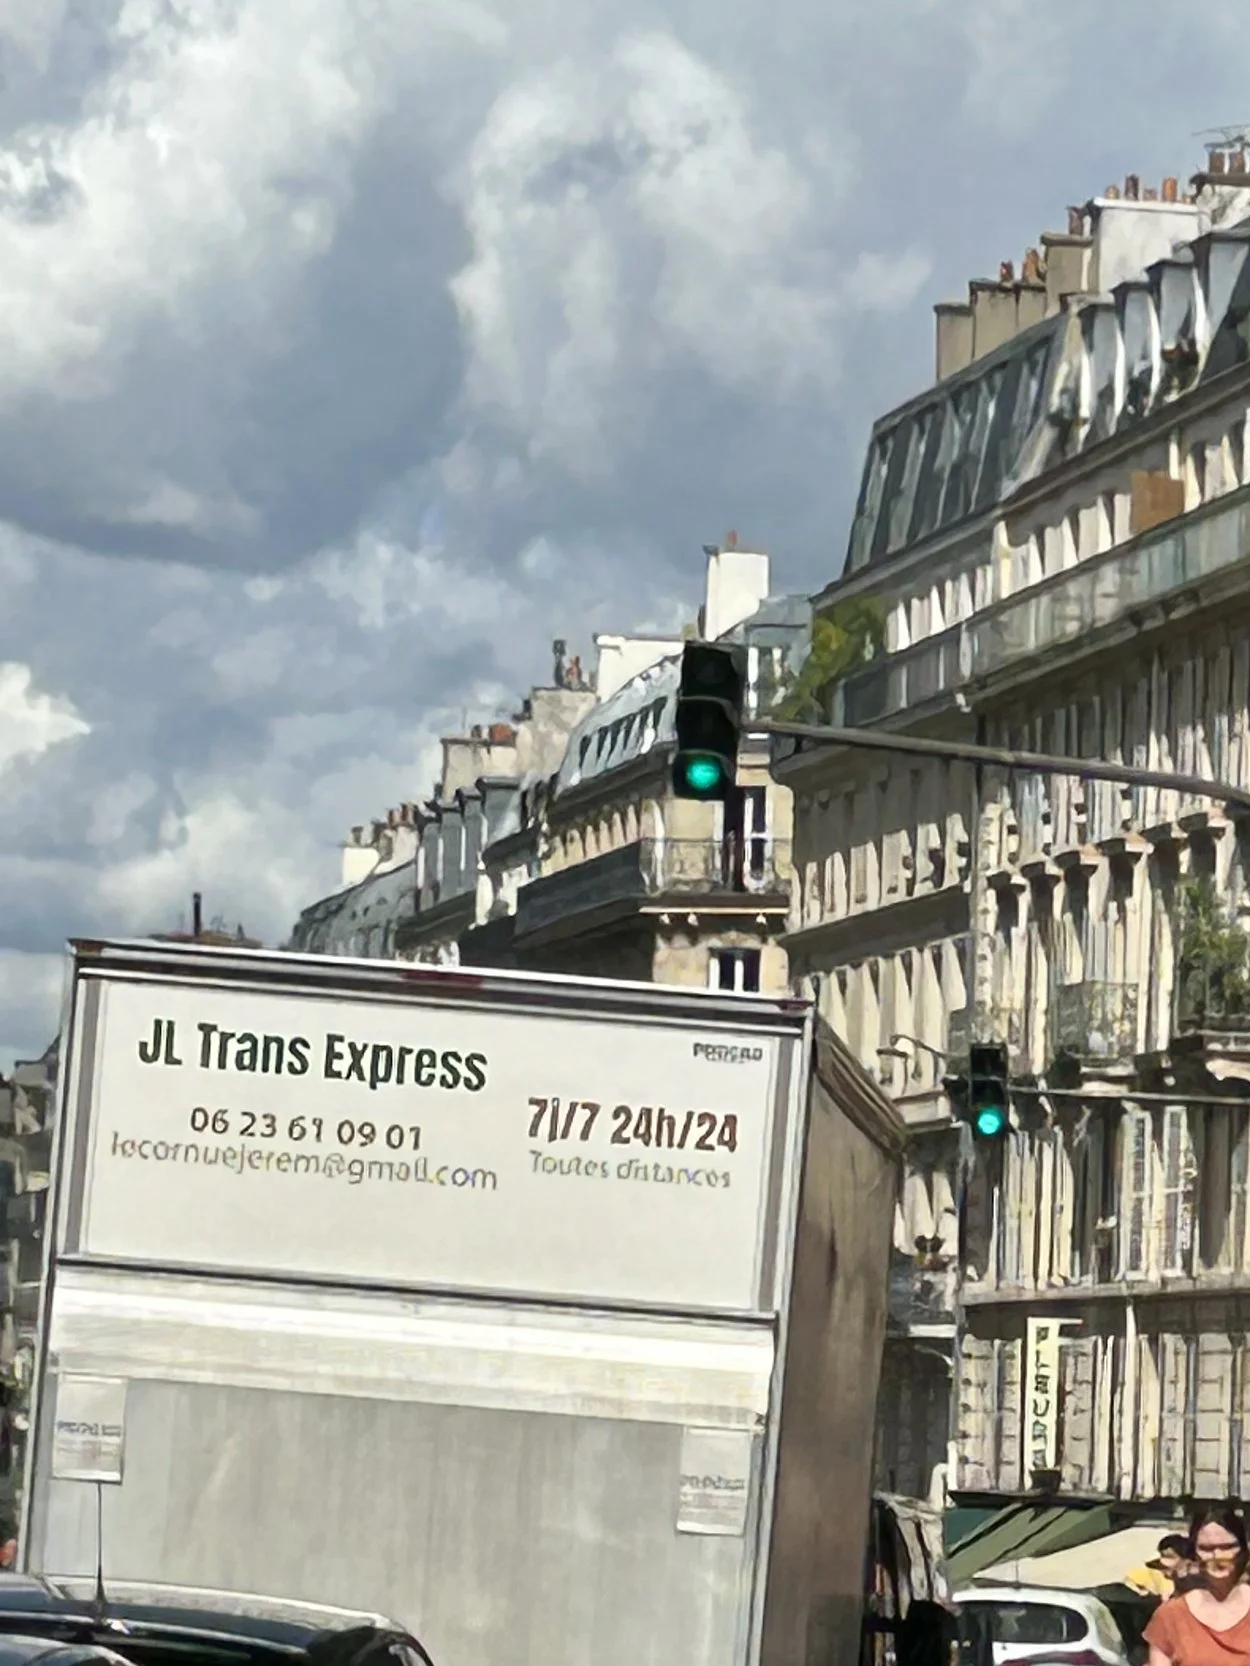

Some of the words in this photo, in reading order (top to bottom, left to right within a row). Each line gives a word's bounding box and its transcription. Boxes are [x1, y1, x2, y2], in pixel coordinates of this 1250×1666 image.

[138, 1018, 183, 1066] JL
[197, 1021, 311, 1076] Trans
[323, 1033, 489, 1092] Express
[190, 1106, 230, 1135] 06
[238, 1111, 278, 1139] 23
[287, 1114, 323, 1143] 61
[336, 1119, 377, 1147] 09
[385, 1124, 422, 1151] 01
[609, 1103, 739, 1153] 24h/24
[529, 1149, 609, 1179] Toutes
